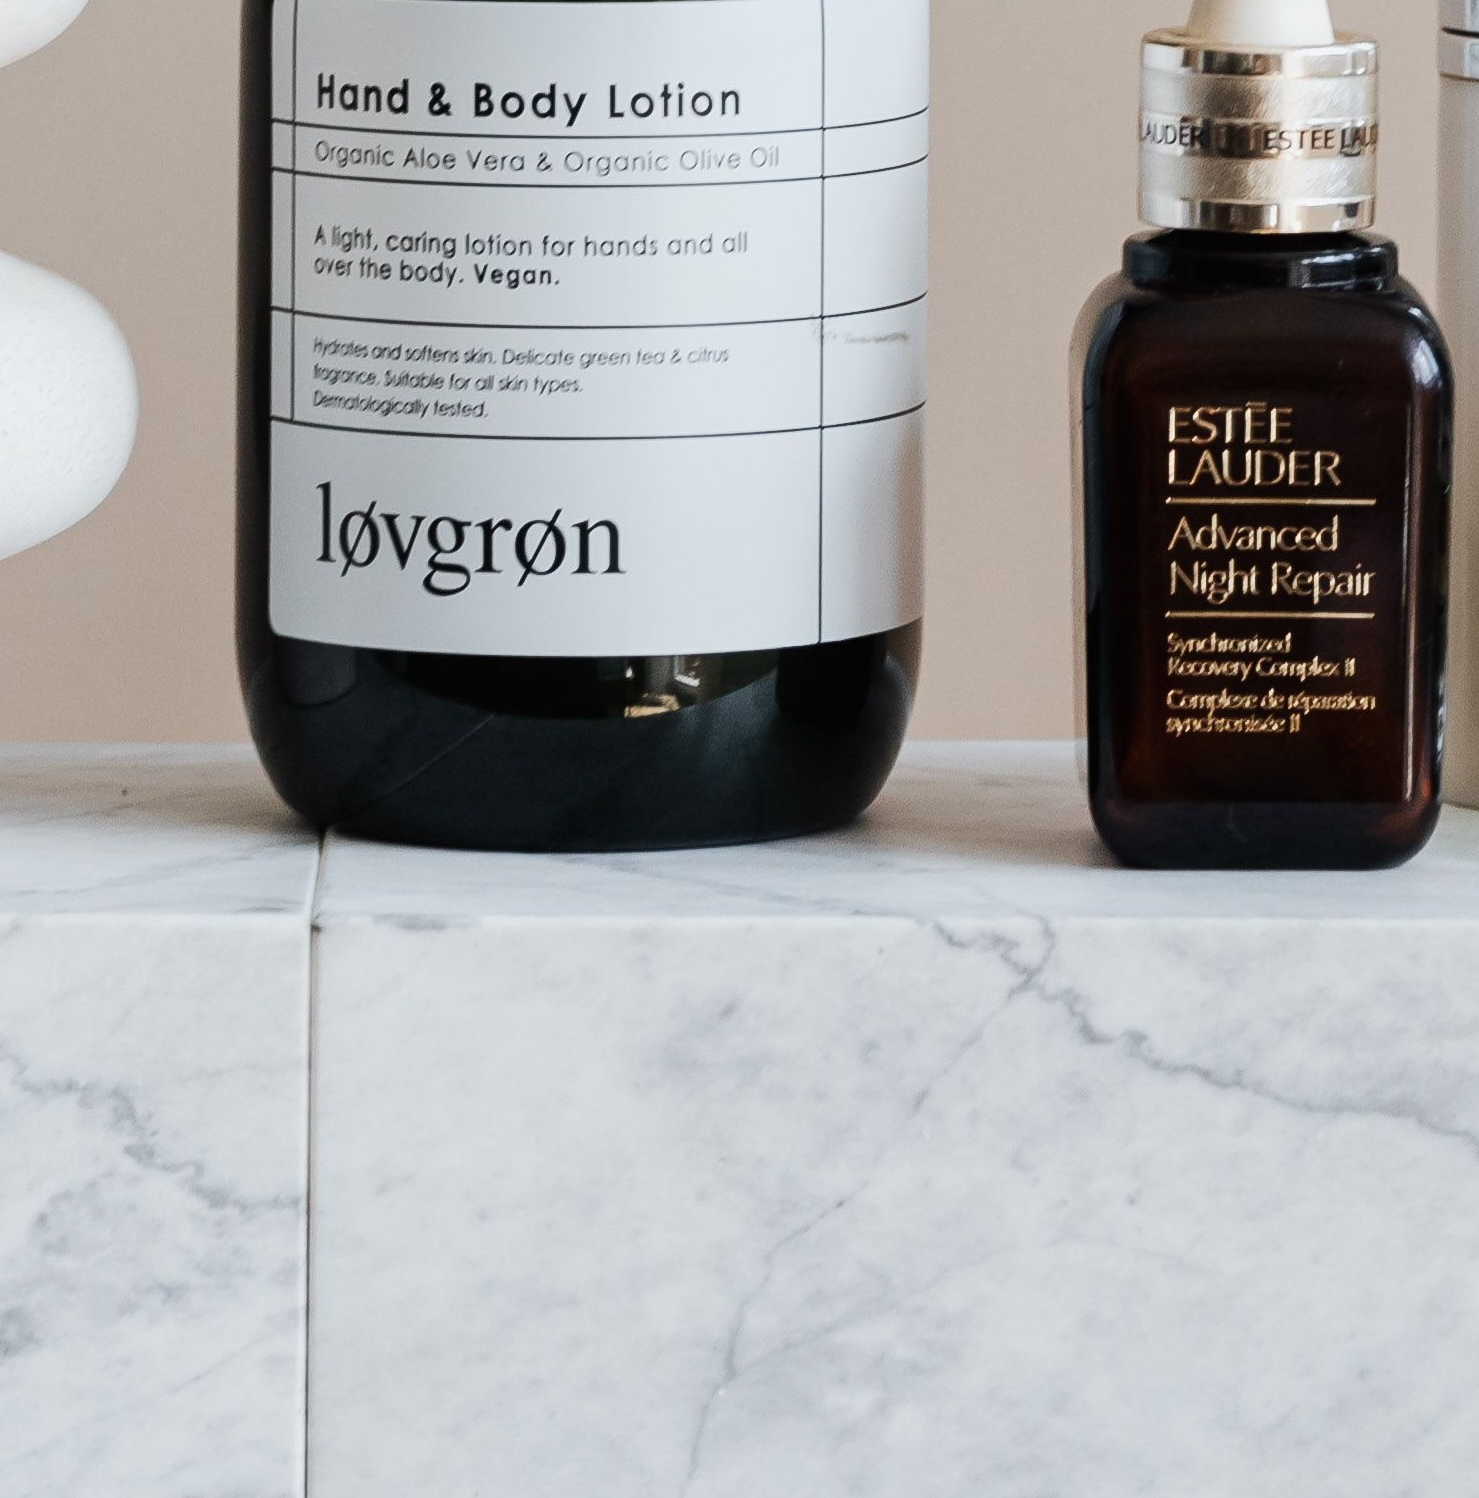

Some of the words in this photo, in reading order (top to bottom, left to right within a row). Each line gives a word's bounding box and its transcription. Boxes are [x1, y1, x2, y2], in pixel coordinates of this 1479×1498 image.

[317, 73, 409, 114] Hand
[428, 82, 452, 116] &
[474, 82, 587, 127] Body
[609, 83, 740, 118] Lotion
[315, 140, 394, 168] Organic
[402, 146, 456, 169] Aloe
[466, 149, 525, 172] Vera
[536, 151, 553, 172] &
[564, 150, 670, 177] Organic
[679, 149, 741, 171] Olive
[750, 145, 779, 168] Oil
[314, 223, 327, 245] A
[331, 224, 378, 252] light,
[385, 230, 456, 259] caring
[466, 233, 532, 256] lotion
[542, 235, 576, 256] for
[583, 235, 658, 256] hands
[668, 233, 713, 255] and
[723, 231, 748, 253] all
[314, 256, 353, 276] over
[359, 257, 392, 280] the
[399, 259, 464, 288] body.
[474, 263, 560, 289] Vegan.
[372, 343, 402, 361] and
[405, 345, 459, 364] softens
[502, 349, 574, 366] Delicate
[579, 351, 631, 370] green
[636, 348, 665, 365] tea
[687, 345, 730, 364] citrus
[384, 370, 445, 390] Suitable
[449, 373, 471, 390] for
[475, 375, 495, 391] all
[498, 375, 528, 392] skin
[1168, 449, 1342, 486] LAUDER
[316, 481, 627, 597] løvgrøn
[1168, 513, 1339, 551] Advanced
[1170, 558, 1260, 604] Night
[1271, 563, 1376, 605] Repair
[1255, 655, 1340, 682] Complex
[1260, 688, 1285, 710] de
